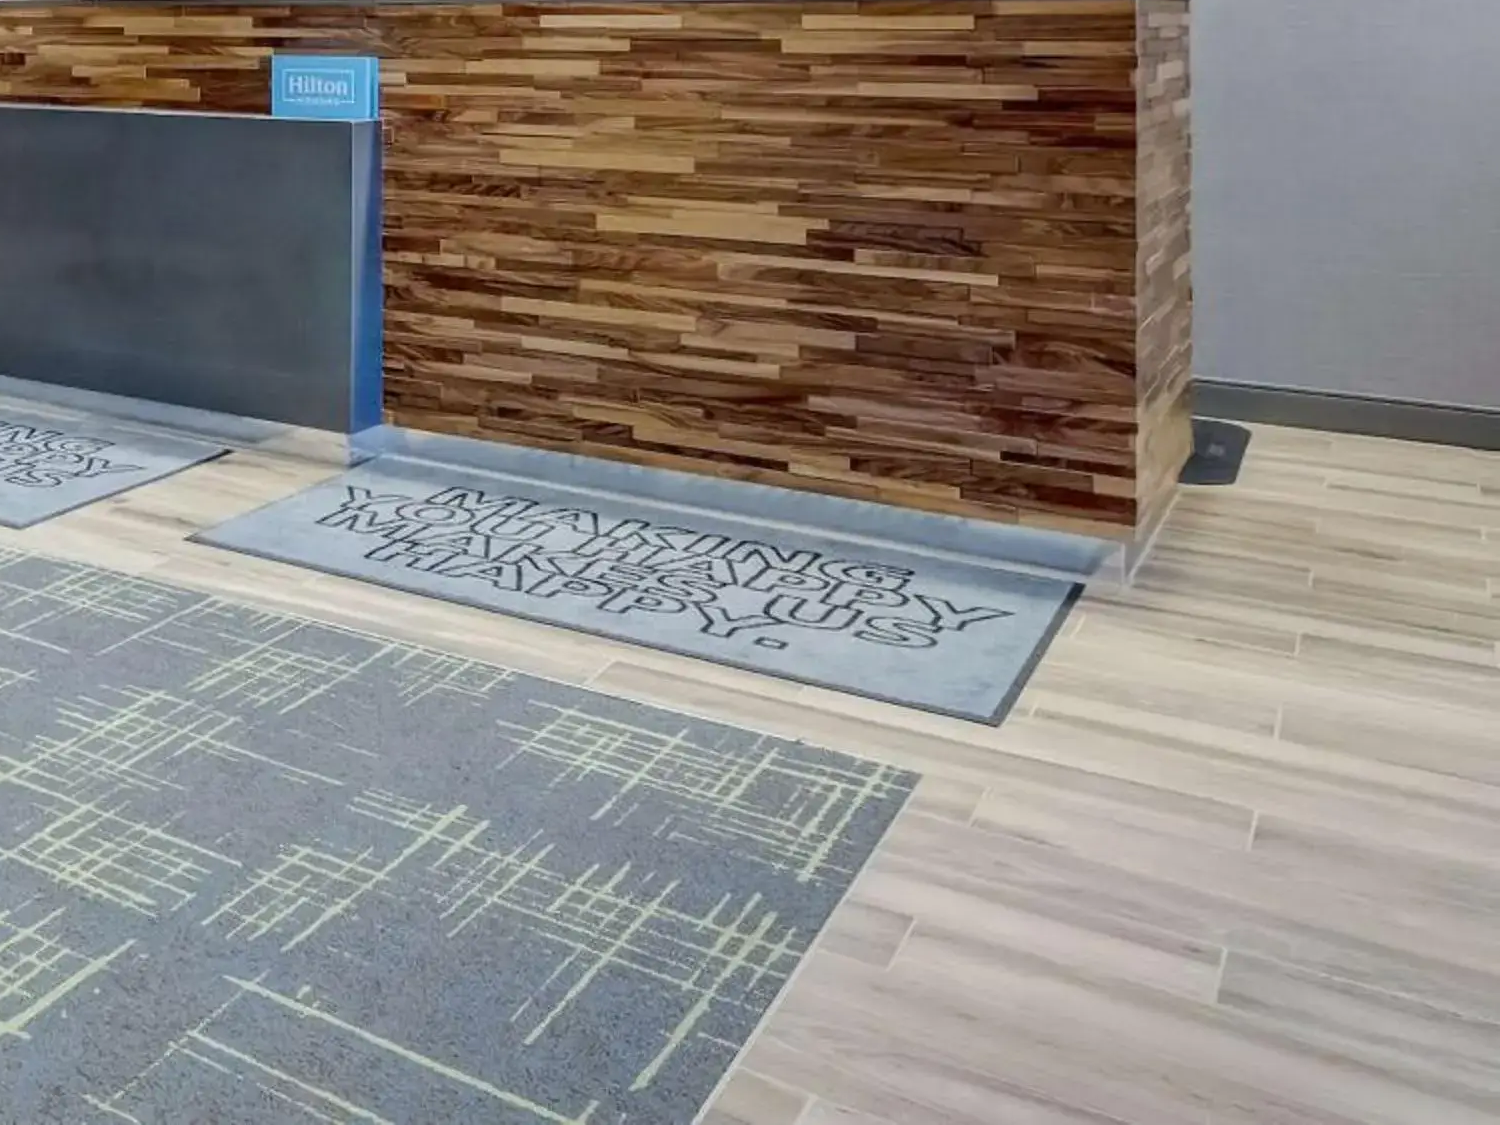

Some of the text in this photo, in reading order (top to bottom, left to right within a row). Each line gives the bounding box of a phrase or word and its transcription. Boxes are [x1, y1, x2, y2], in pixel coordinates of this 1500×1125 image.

[288, 75, 348, 95] Hilton
[425, 486, 915, 590] MAKING
[764, 594, 939, 648] US
